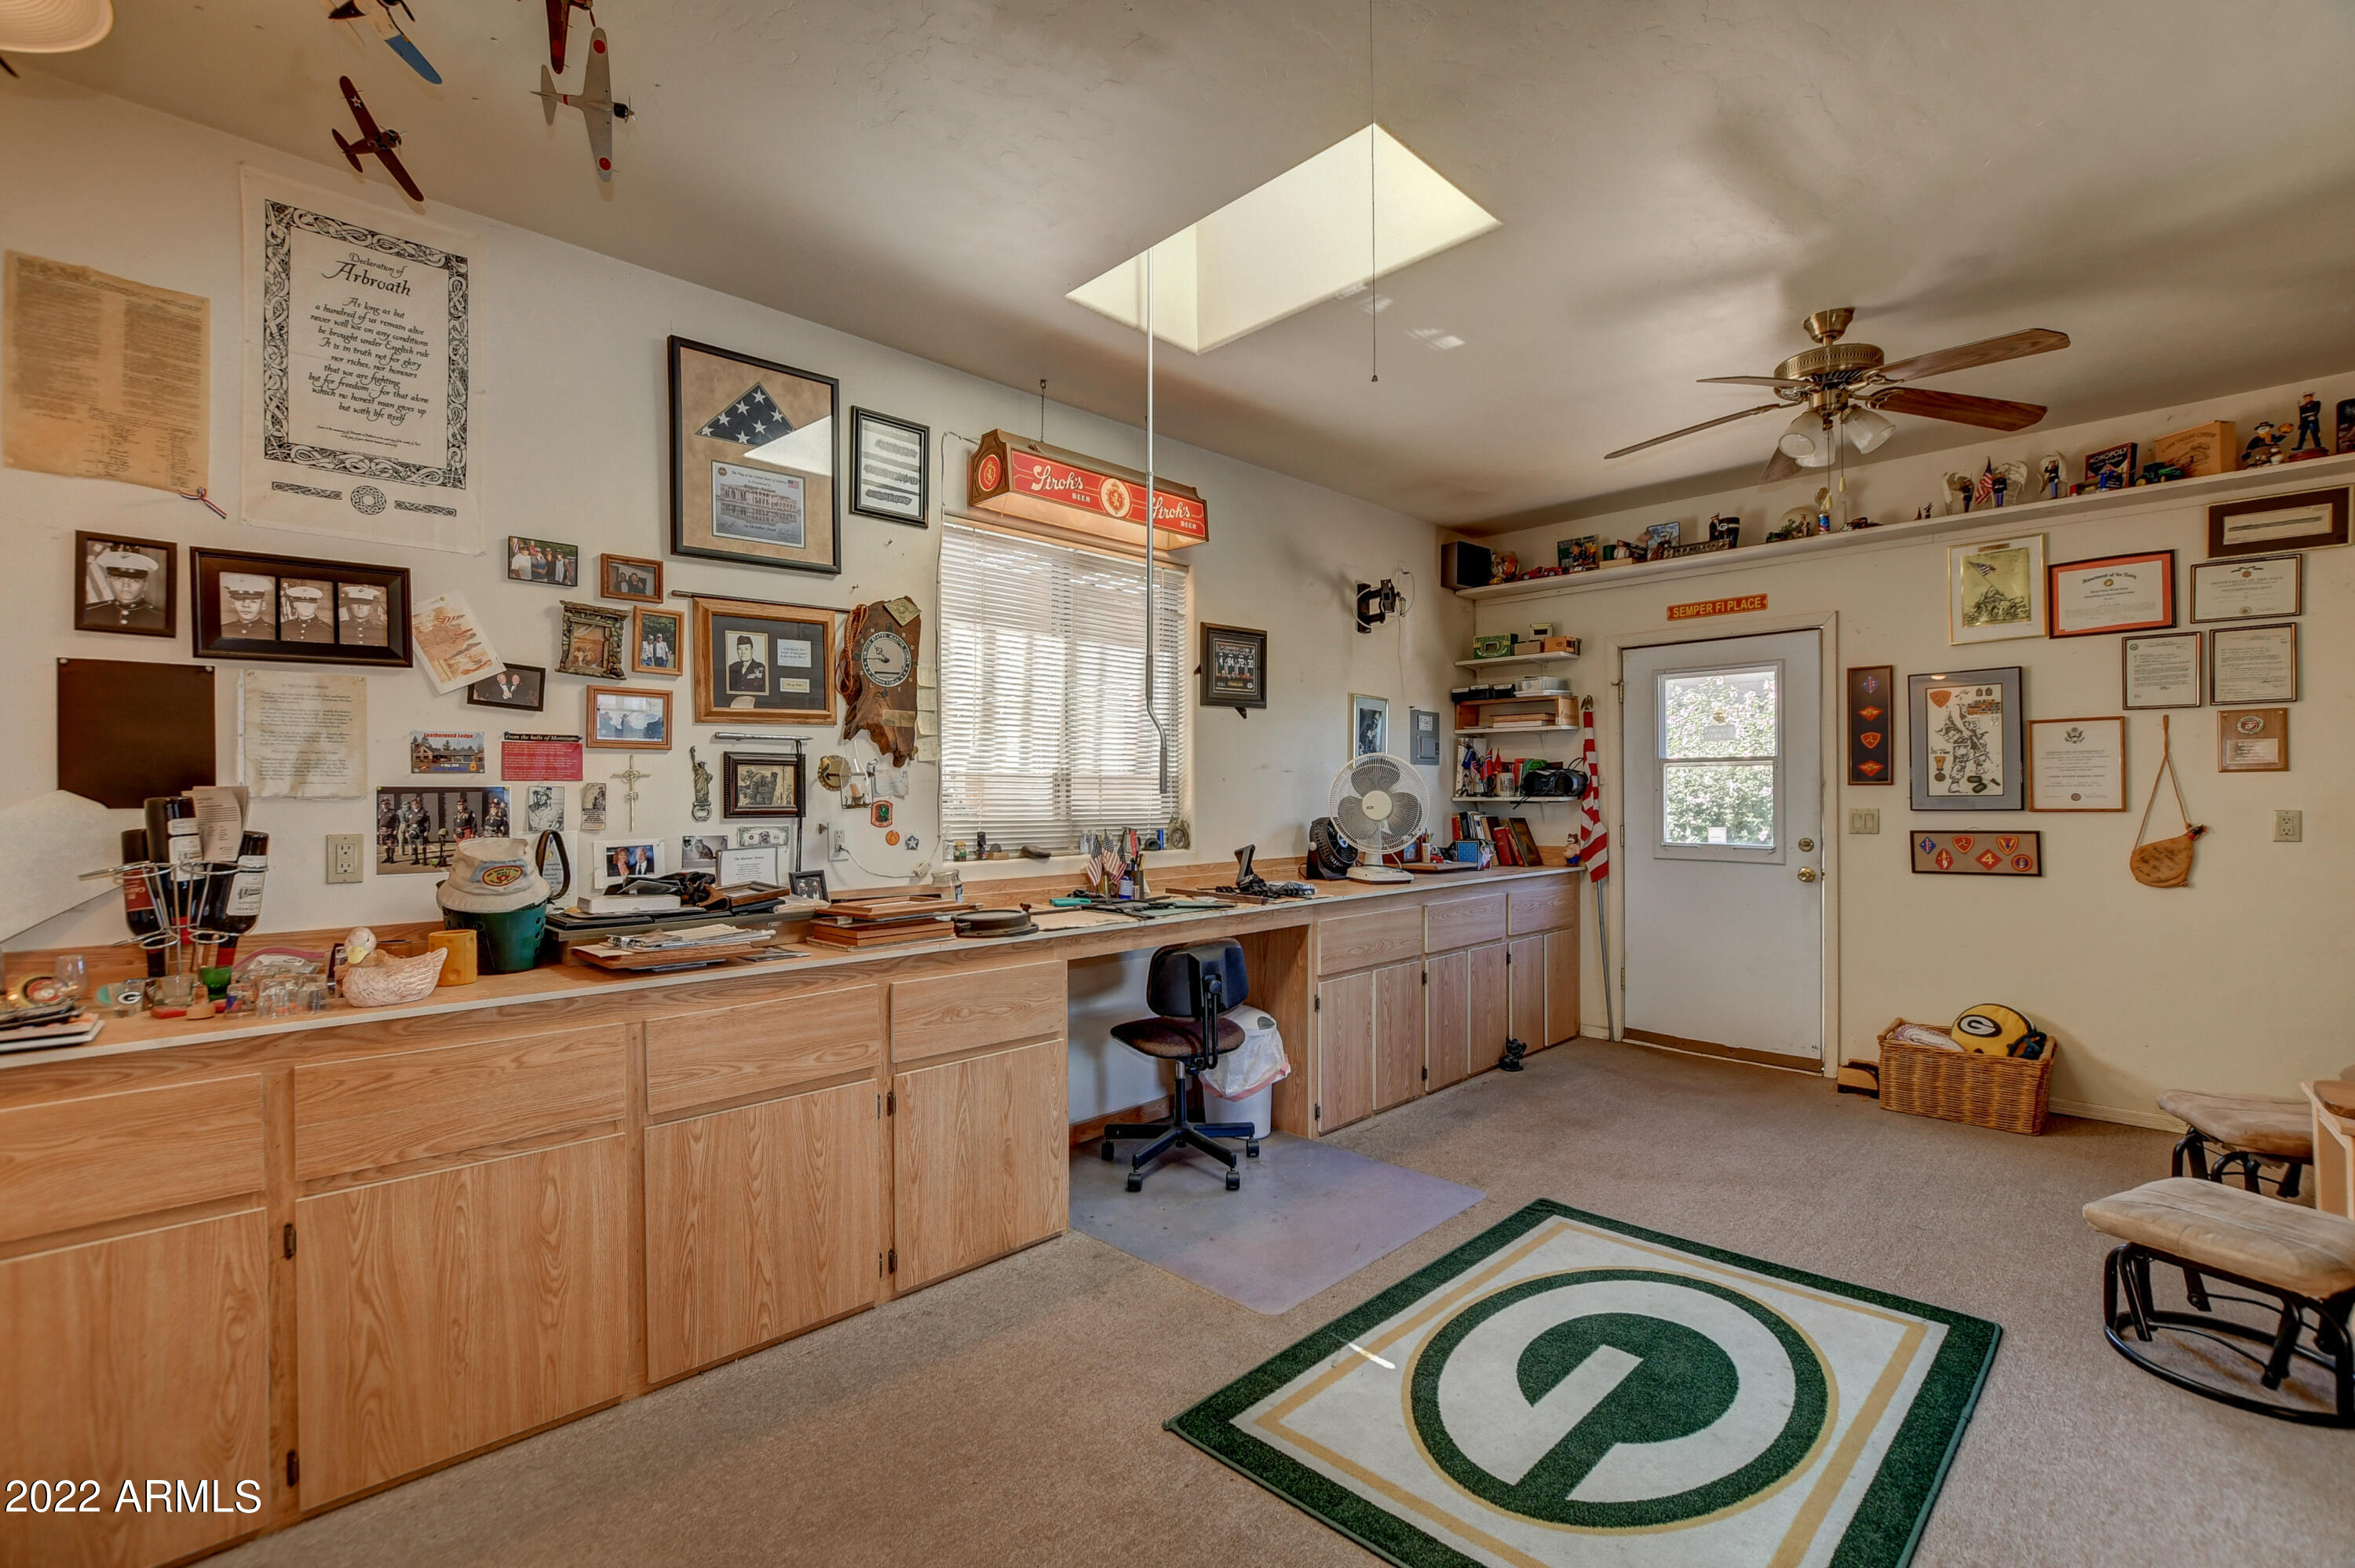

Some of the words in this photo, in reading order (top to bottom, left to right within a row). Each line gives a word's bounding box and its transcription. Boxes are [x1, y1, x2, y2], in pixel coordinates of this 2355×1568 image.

[349, 253, 394, 273] Declaration
[321, 261, 411, 297] Arbroath
[323, 304, 355, 318] hundred
[380, 320, 406, 331] remain
[407, 326, 425, 335] alive
[342, 297, 361, 308] As
[364, 302, 381, 316] long
[393, 309, 405, 319] but
[310, 314, 330, 323] never
[334, 319, 349, 328] will
[376, 330, 391, 341] any
[392, 334, 429, 347] conditions
[318, 326, 327, 334] be
[329, 328, 358, 344] brought
[360, 337, 382, 348] under
[385, 340, 414, 356] English
[416, 349, 430, 359] rule
[319, 337, 330, 348] It
[353, 347, 372, 358] truth
[401, 358, 422, 371] glory
[323, 364, 340, 374] that
[360, 371, 401, 390] fighting
[389, 366, 418, 378] honours
[309, 372, 321, 382] but
[327, 377, 369, 392] freedom
[393, 391, 408, 399] that
[411, 394, 429, 403] alone
[312, 385, 336, 398] which
[351, 392, 375, 404] honest
[395, 404, 414, 414] gives
[418, 408, 427, 418] up
[338, 402, 351, 412] but
[353, 407, 371, 416] with
[387, 412, 409, 426] itself
[2089, 447, 2128, 463] MONOPOLY
[1031, 465, 1085, 491] Stroh's
[1072, 492, 1091, 503] BEER
[1181, 520, 1197, 530] BEER
[1673, 603, 1713, 618] SEMPER
[1716, 602, 1725, 613] FI
[1727, 597, 1762, 611] PLACE
[1981, 853, 1995, 865] 4
